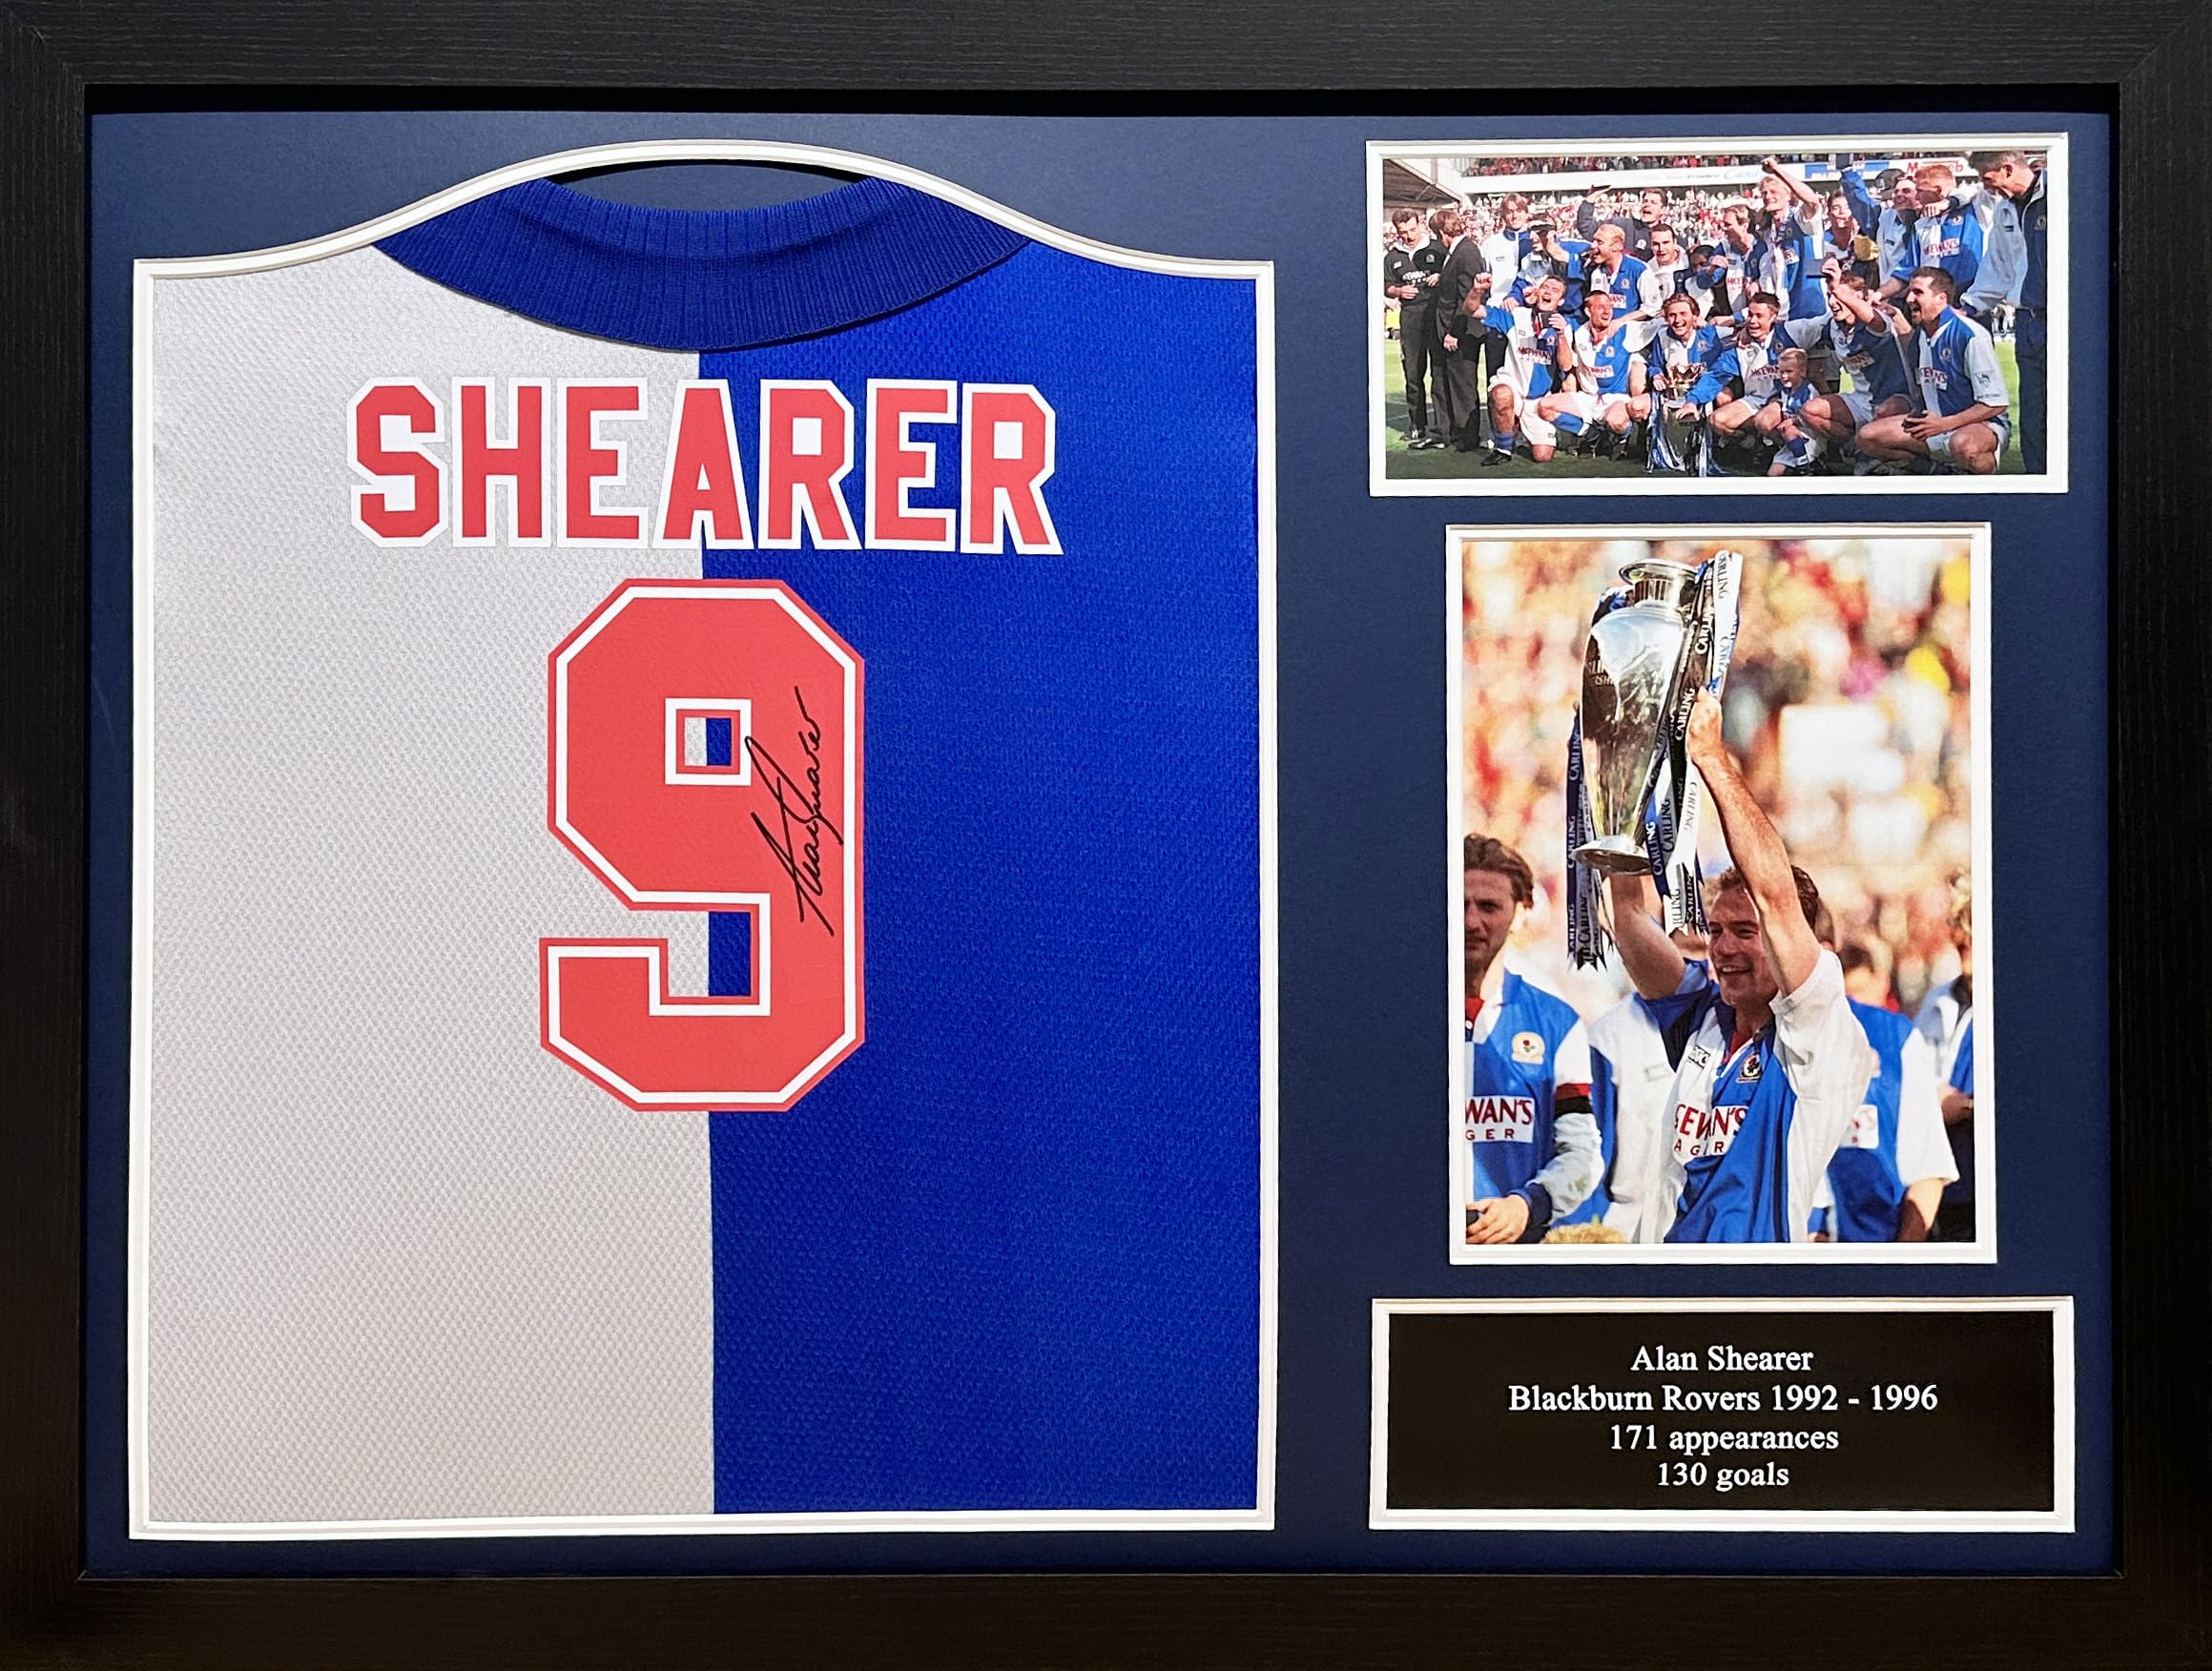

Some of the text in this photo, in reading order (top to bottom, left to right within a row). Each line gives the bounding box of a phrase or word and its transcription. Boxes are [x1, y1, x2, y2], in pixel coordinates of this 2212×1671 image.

[346, 377, 1065, 555] SHEARER
[1674, 686, 1696, 741] CARLING
[1662, 798, 1675, 853] CARLING
[1683, 781, 1698, 832] CARLING
[540, 579, 865, 1111] 9
[1645, 820, 1664, 877] CARLING
[1465, 1129, 1515, 1142] GER
[1630, 1344, 1814, 1372] Alan Shearer
[1508, 1384, 1654, 1412] Blackburn
[1661, 1384, 1761, 1412] Rovers
[1771, 1384, 1839, 1412] 1992
[1871, 1384, 1938, 1411] 1996
[1611, 1424, 1839, 1457] 171 appearances
[1658, 1461, 1789, 1493] 130 goals
